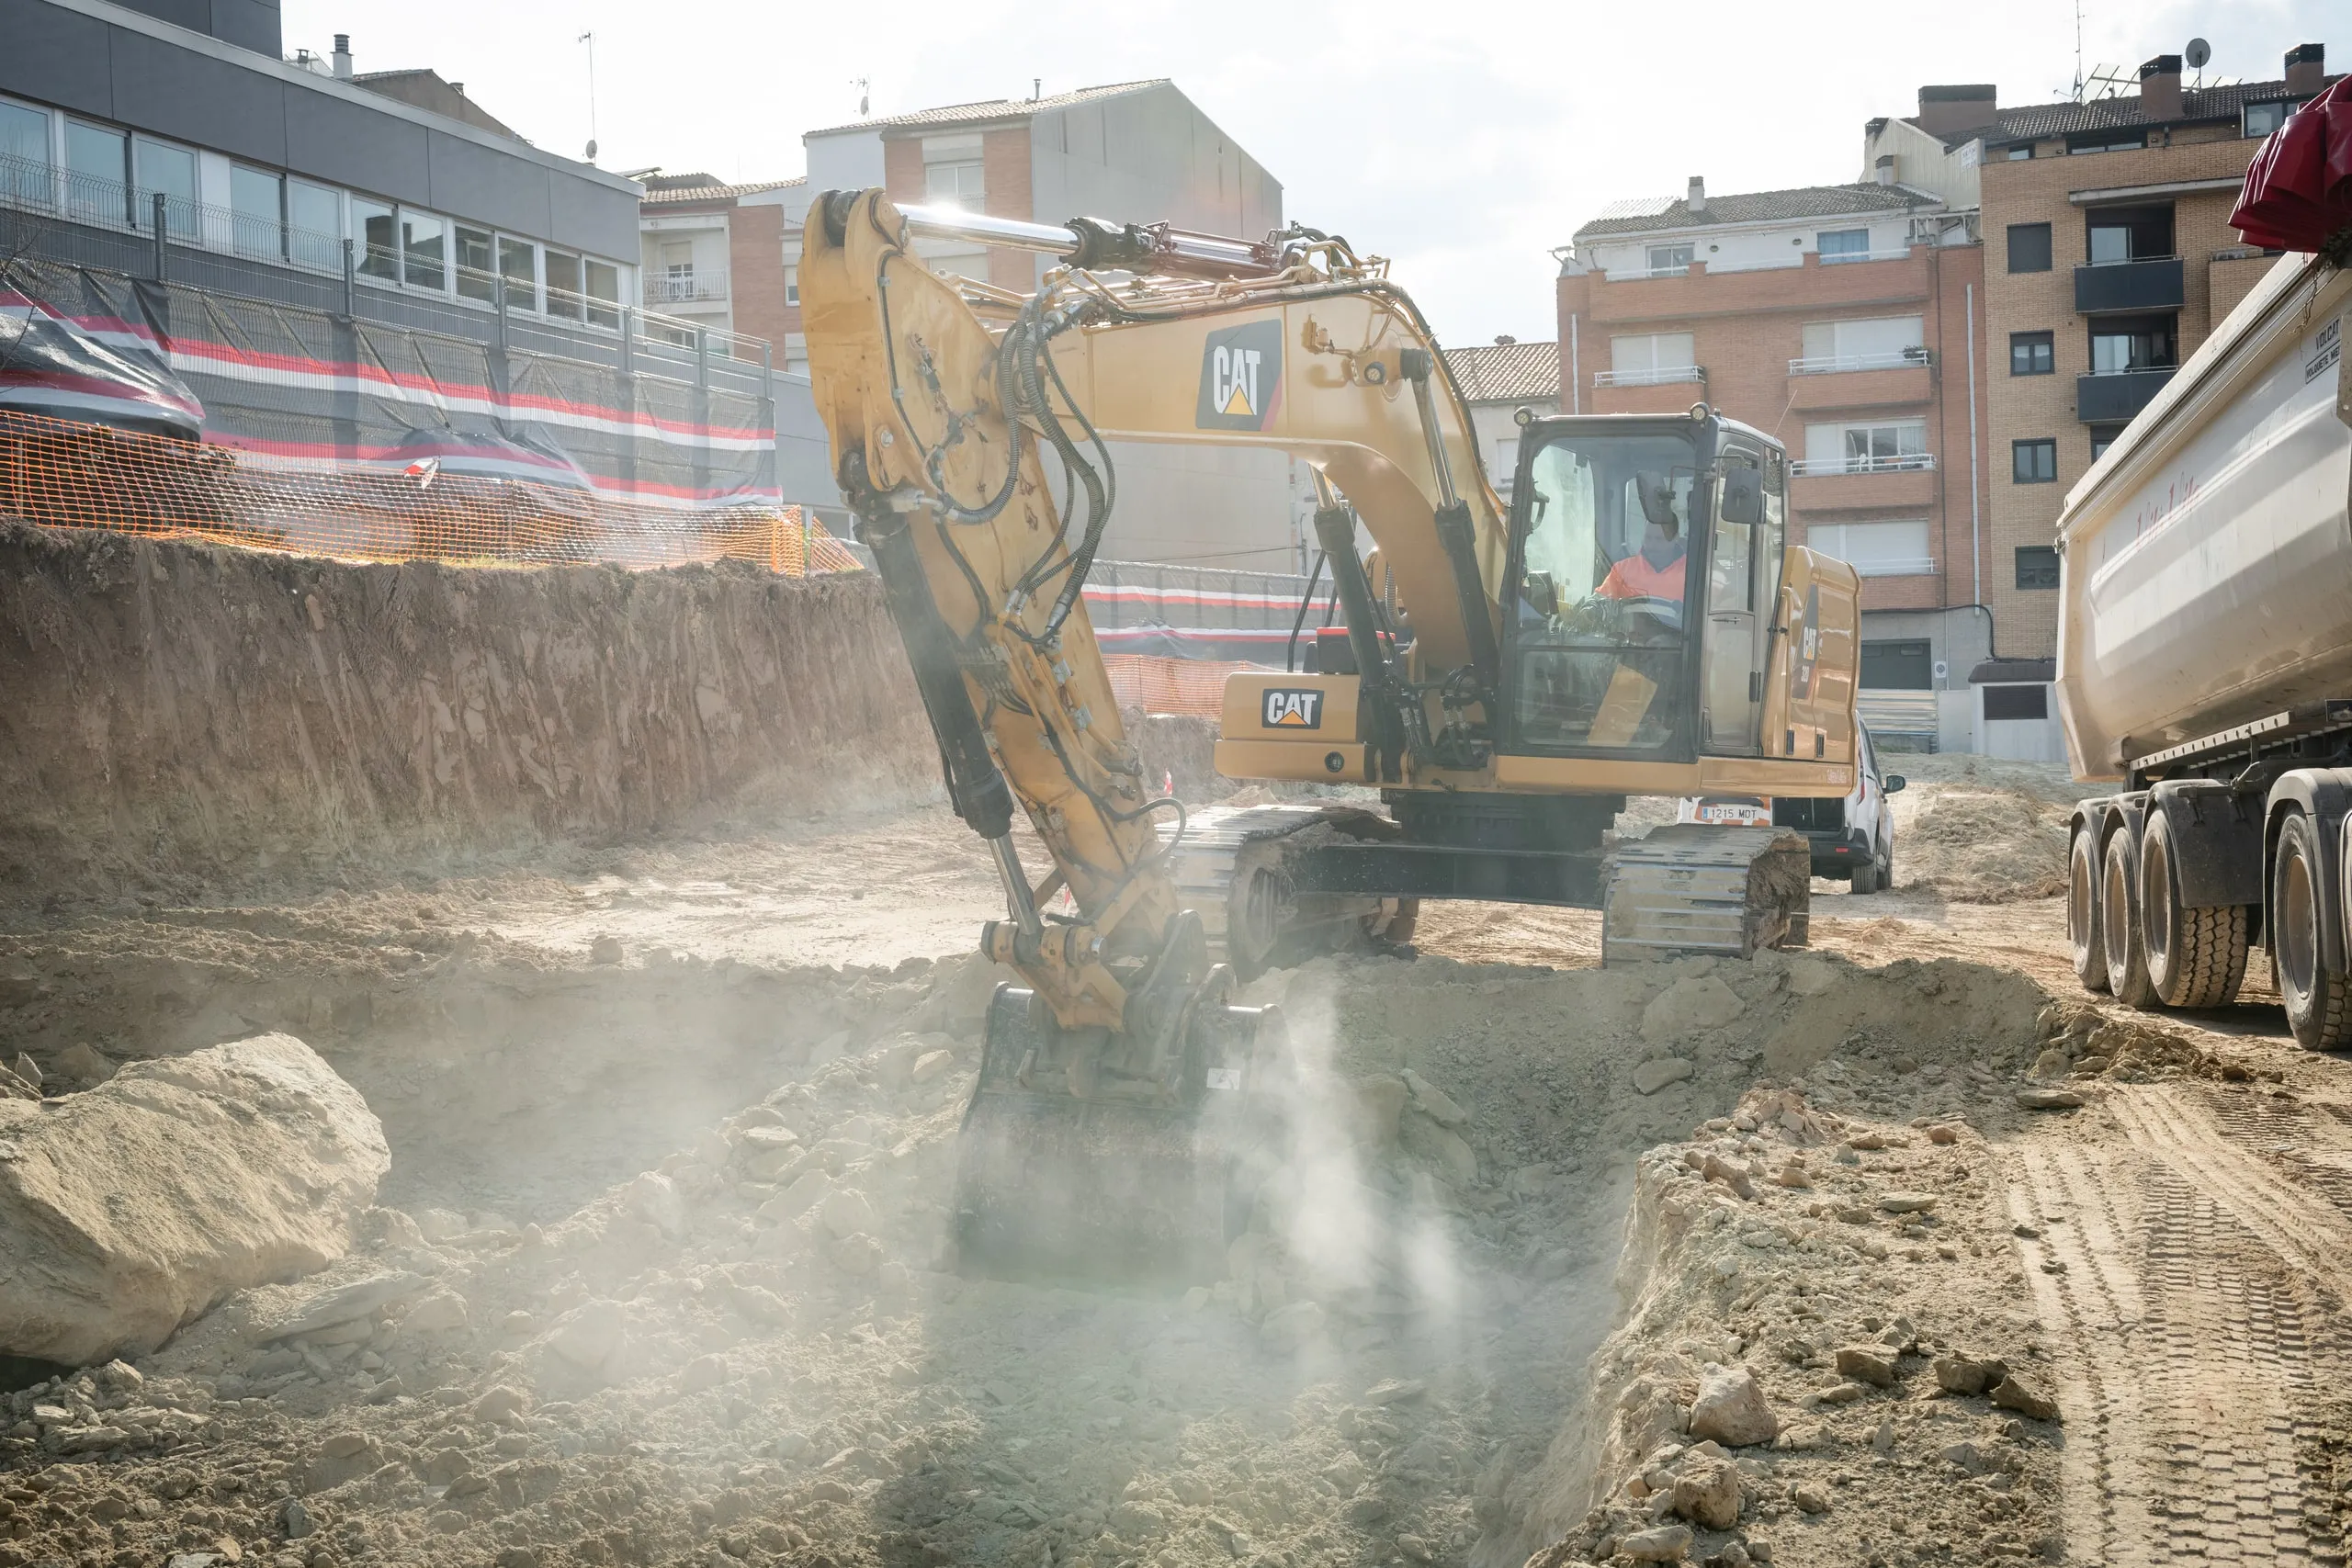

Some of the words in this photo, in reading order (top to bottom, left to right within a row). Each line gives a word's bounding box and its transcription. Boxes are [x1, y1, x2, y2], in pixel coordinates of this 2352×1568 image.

[1214, 345, 1261, 416] CAT
[1803, 626, 1816, 660] CAT
[1267, 693, 1317, 725] CAT
[1712, 808, 1734, 818] 1215
